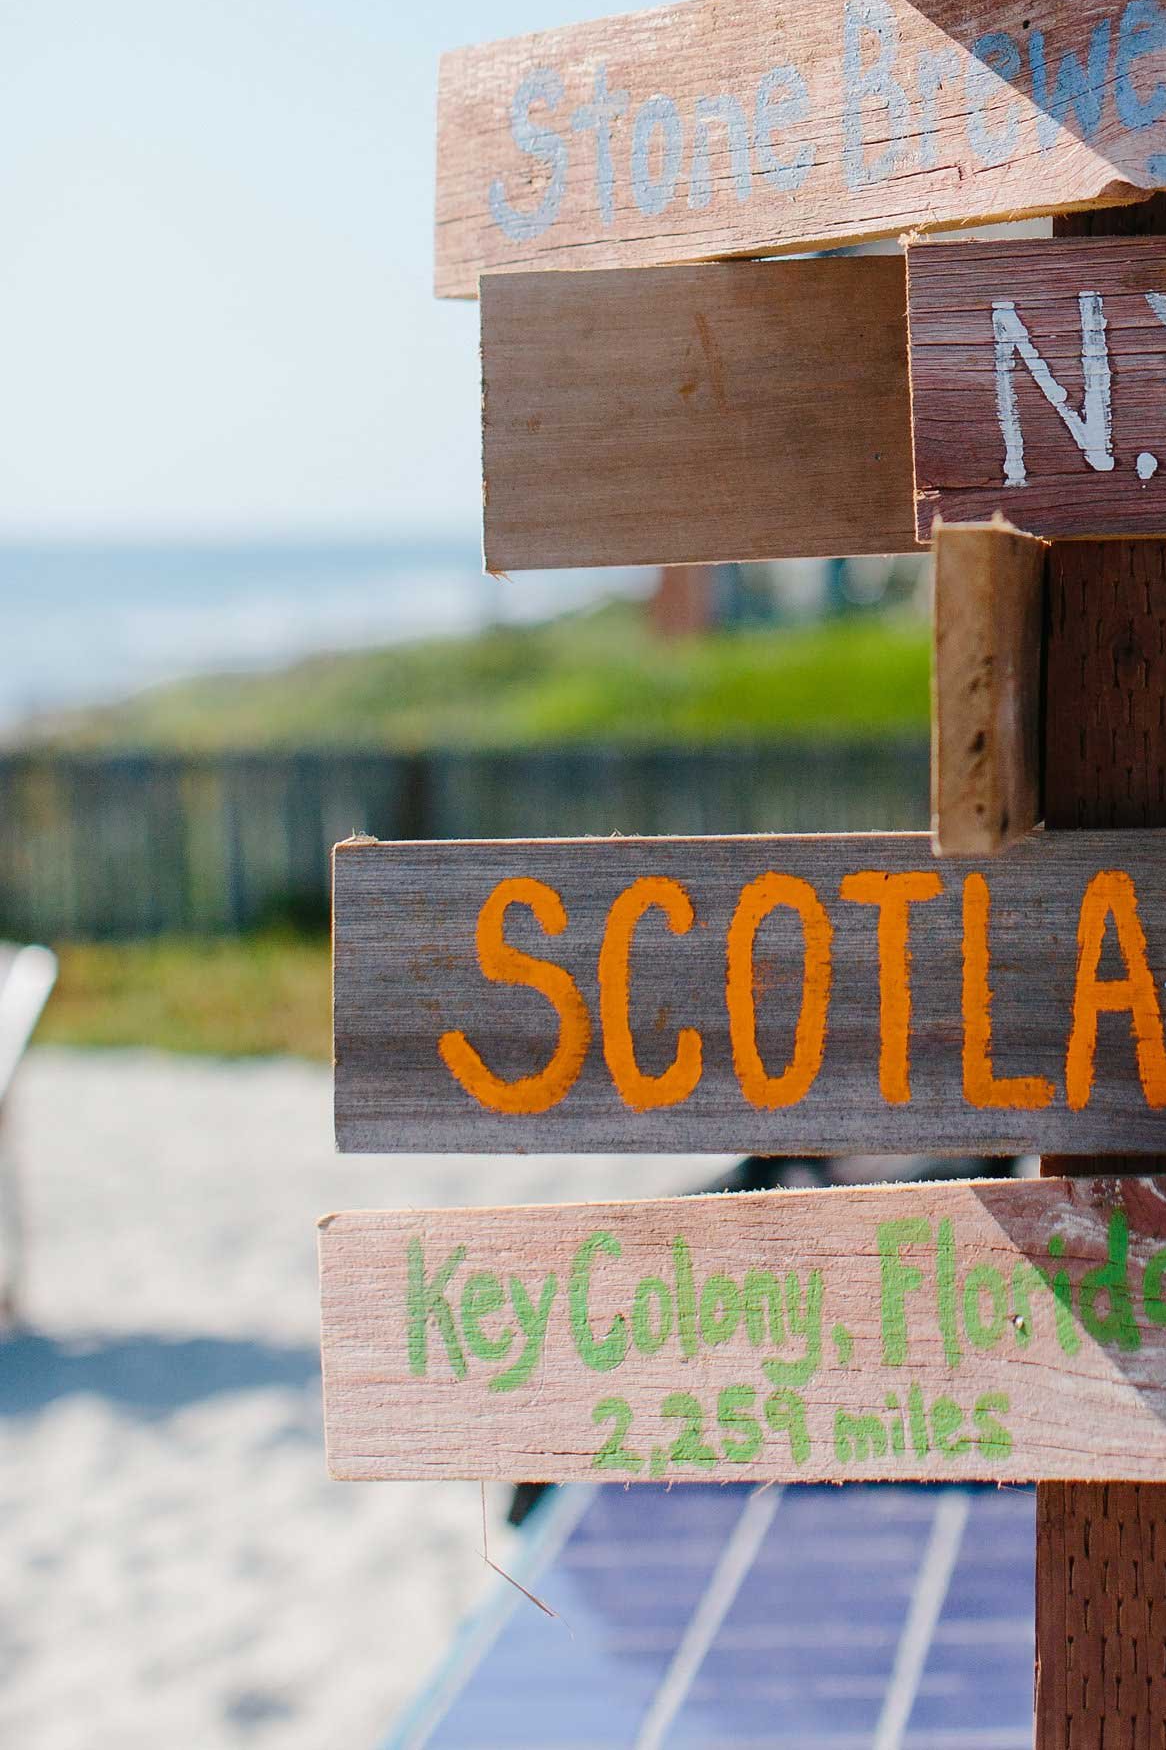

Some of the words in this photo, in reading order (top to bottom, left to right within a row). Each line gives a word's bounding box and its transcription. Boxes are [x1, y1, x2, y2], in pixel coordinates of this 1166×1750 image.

[488, 57, 812, 243] Stone
[405, 1235, 558, 1394] Key
[567, 1229, 853, 1388] Colony,
[591, 1383, 811, 1479] 2,259
[833, 1380, 1013, 1465] miles
